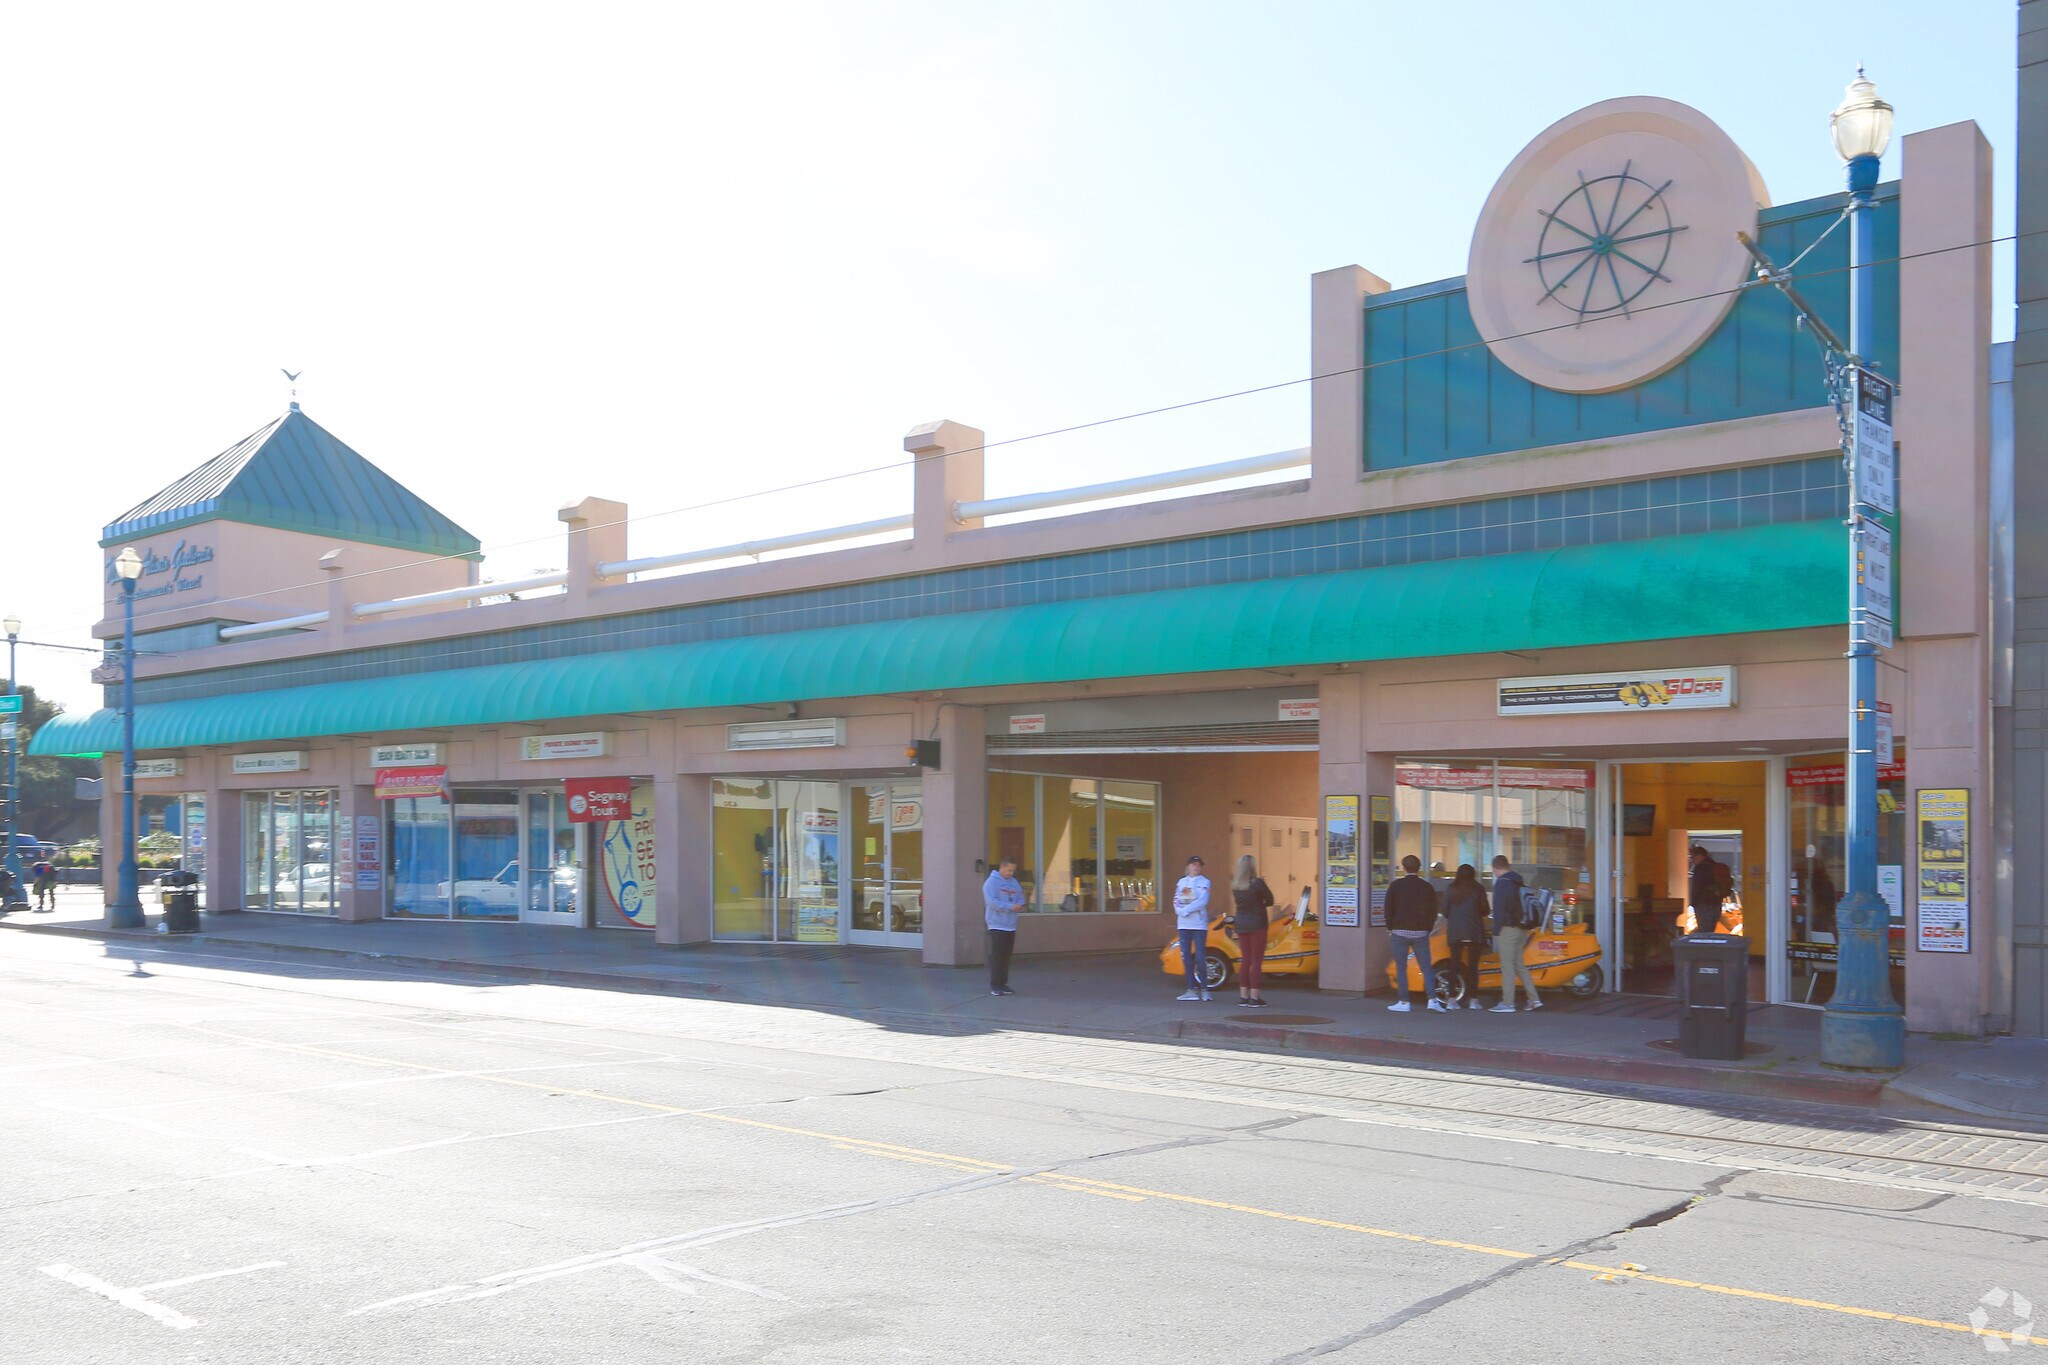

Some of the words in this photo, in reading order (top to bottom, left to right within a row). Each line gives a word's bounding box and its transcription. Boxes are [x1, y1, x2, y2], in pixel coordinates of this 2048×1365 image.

[1863, 375, 1887, 401] RIGHT
[1864, 397, 1886, 420] LANE
[1861, 418, 1889, 446] TRANSIT
[1867, 465, 1885, 486] ONLY
[1869, 560, 1886, 582] MUST
[377, 751, 394, 761] BEACH
[395, 750, 414, 761] BEAUTY
[588, 790, 629, 804] Segway
[1920, 793, 1946, 801] GPS
[591, 805, 619, 816] Tours
[1920, 801, 1968, 809] GUIDED
[360, 841, 376, 851] HAIR
[359, 851, 376, 861] NAIL
